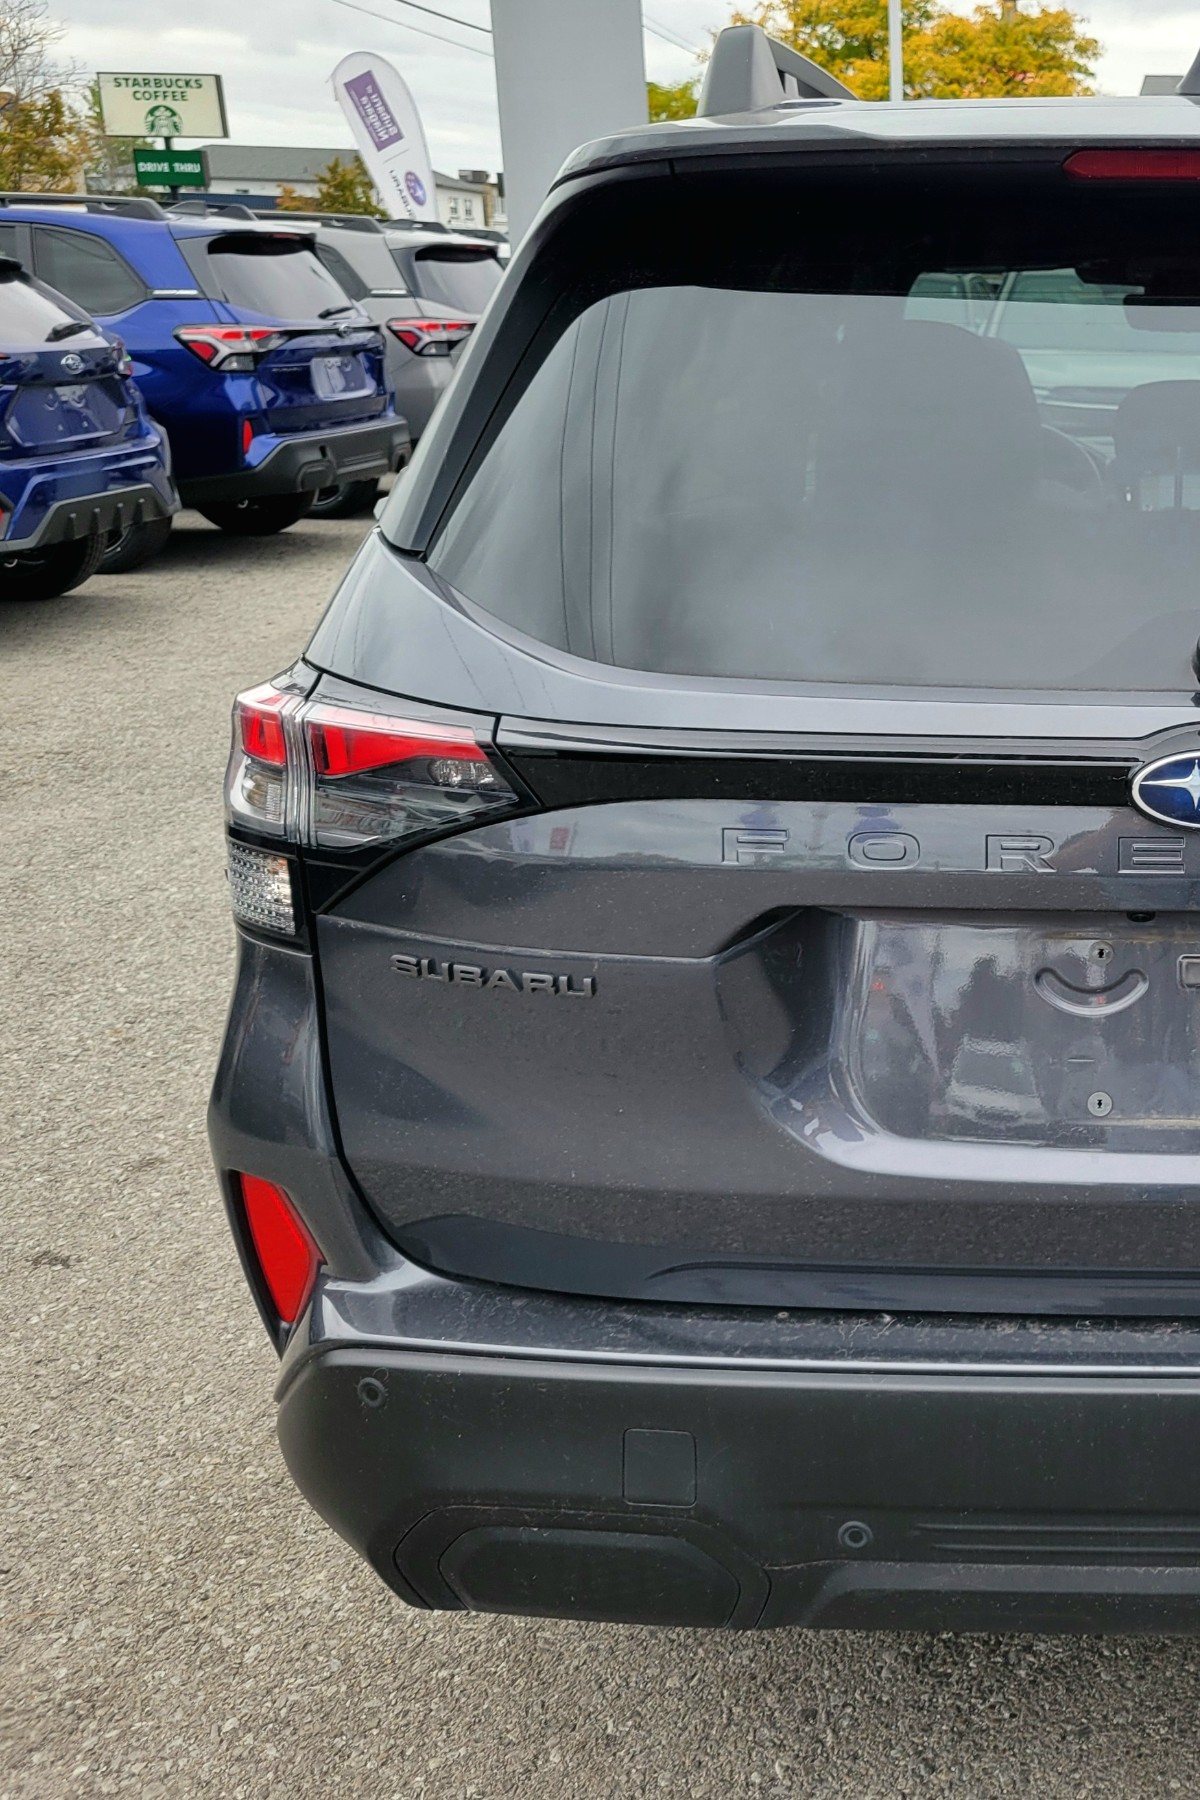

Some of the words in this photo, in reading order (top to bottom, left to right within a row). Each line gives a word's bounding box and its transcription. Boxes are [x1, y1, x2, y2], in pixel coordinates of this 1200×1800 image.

[113, 77, 203, 89] STARBUCKS
[132, 90, 189, 101] COFFEE
[137, 162, 170, 173] DRIVE
[172, 162, 201, 173] THRU
[390, 954, 597, 998] SUBARU
